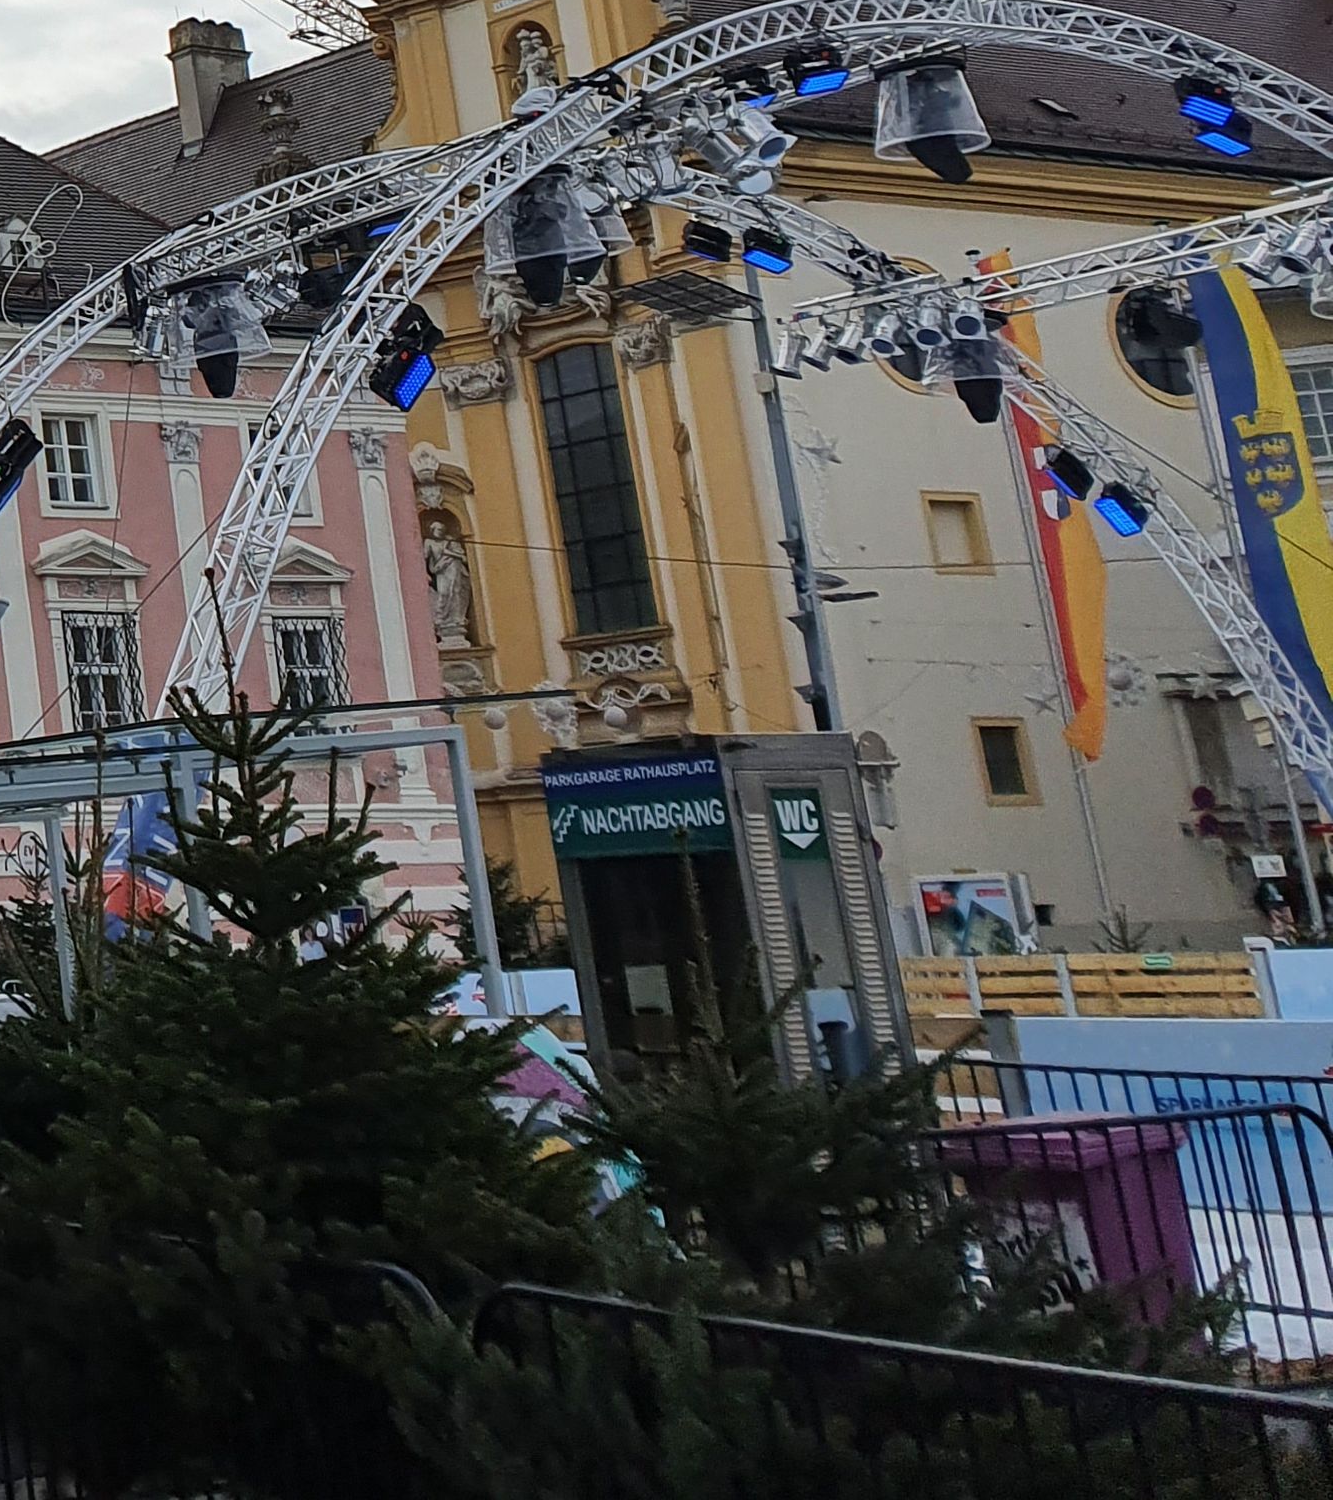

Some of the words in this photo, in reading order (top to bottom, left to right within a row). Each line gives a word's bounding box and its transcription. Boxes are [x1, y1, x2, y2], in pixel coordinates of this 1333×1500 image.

[544, 768, 622, 788] PARKGARAGE
[623, 759, 716, 781] RATHAUSPLATZ
[581, 798, 726, 835] NACHTABGANG
[774, 799, 819, 832] WC
